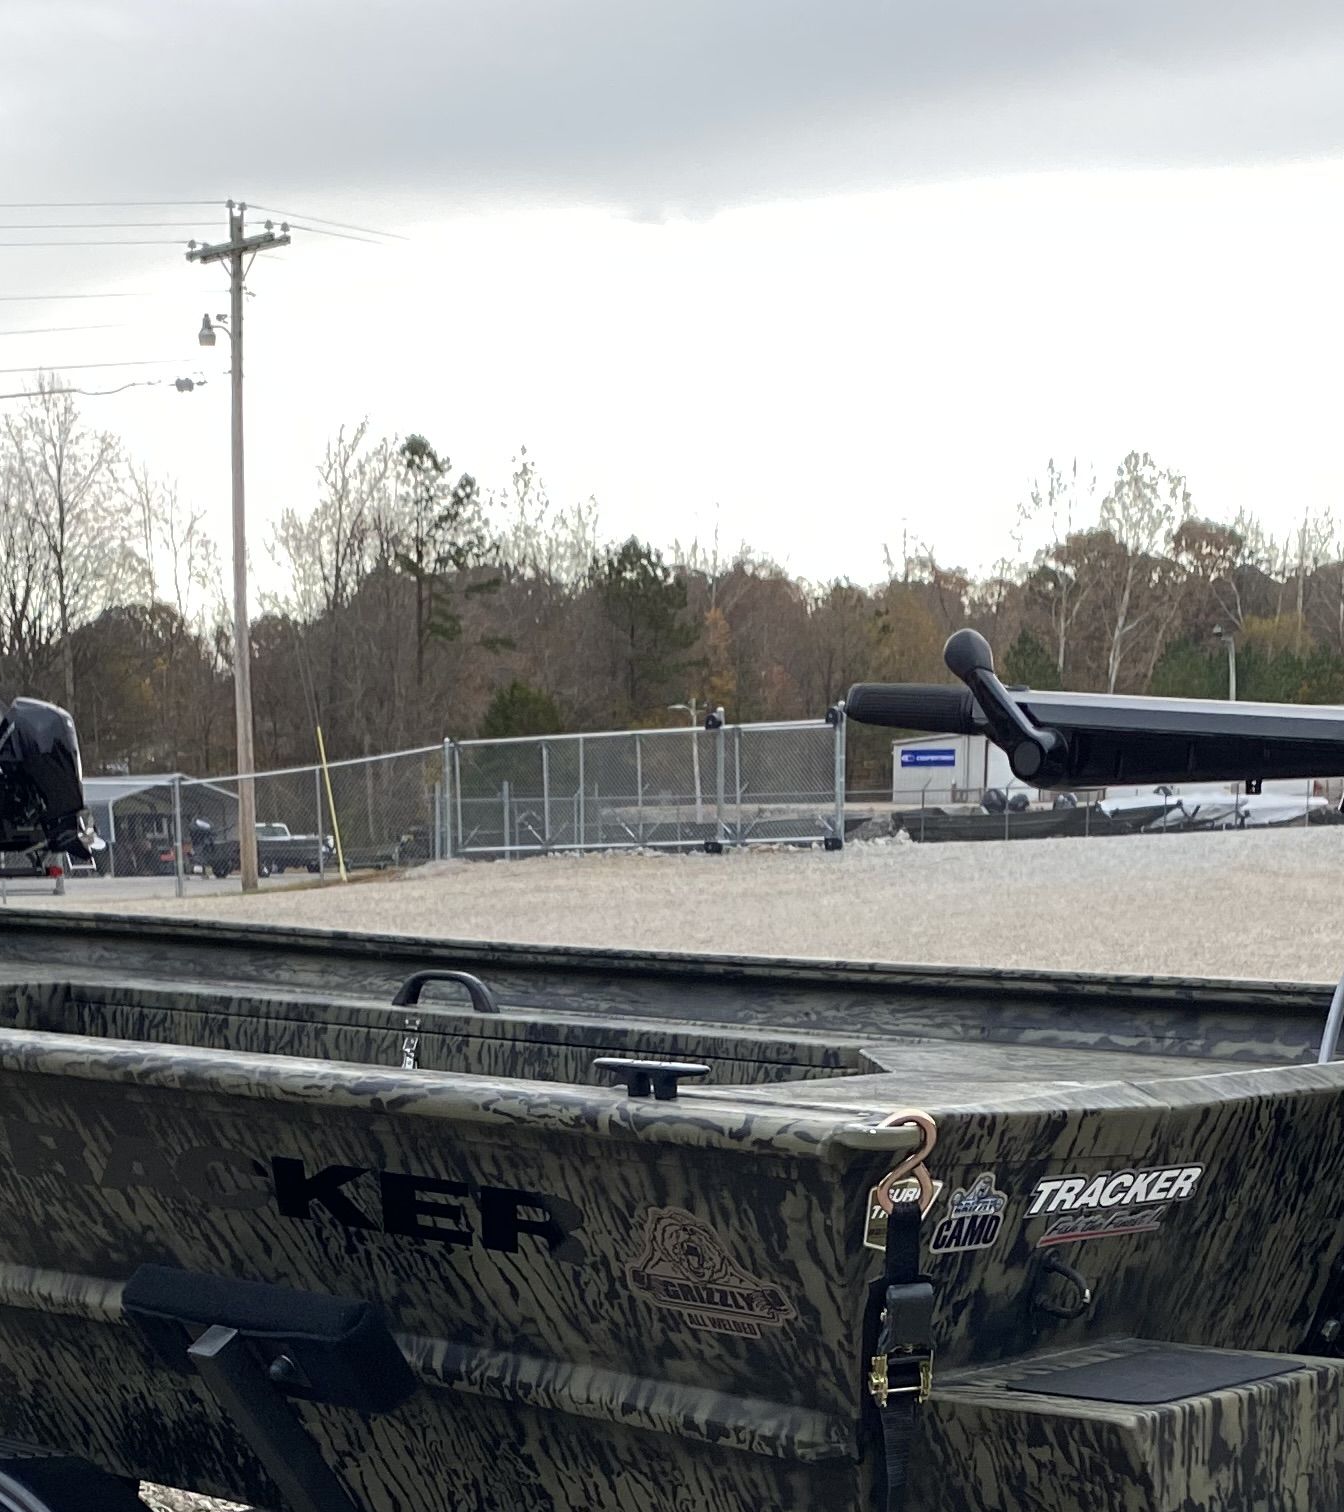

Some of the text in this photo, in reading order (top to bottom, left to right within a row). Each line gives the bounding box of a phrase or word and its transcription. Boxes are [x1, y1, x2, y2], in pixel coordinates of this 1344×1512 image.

[1029, 1167, 1202, 1215] TRACKER
[932, 1214, 1002, 1250] CAMO
[662, 1280, 758, 1312] GRIZZLY
[687, 1312, 758, 1336] ALL WELDED
